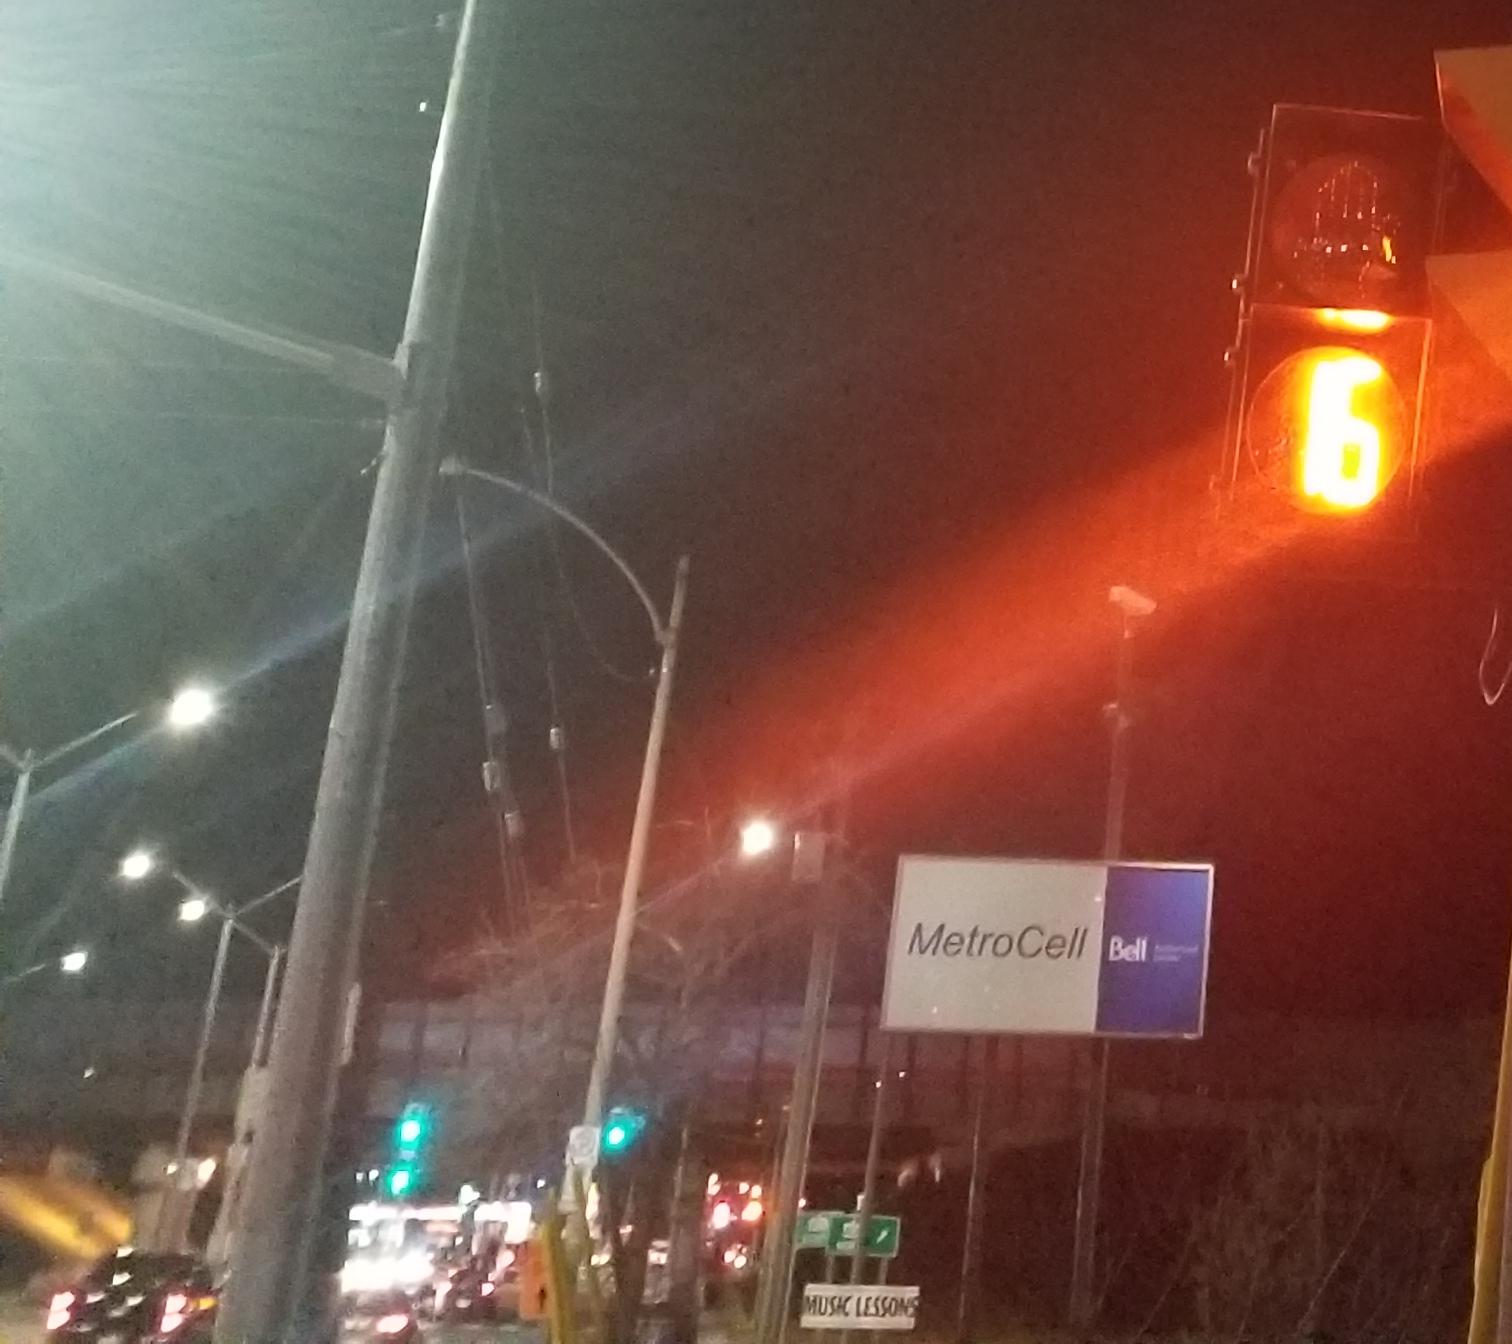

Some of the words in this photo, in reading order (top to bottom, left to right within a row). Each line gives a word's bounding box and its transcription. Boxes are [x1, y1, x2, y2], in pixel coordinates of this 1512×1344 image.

[907, 921, 1089, 961] MetroCell
[1108, 934, 1148, 962] Bell
[805, 1295, 852, 1317] MUSIC
[855, 1296, 920, 1318] LESSONS
